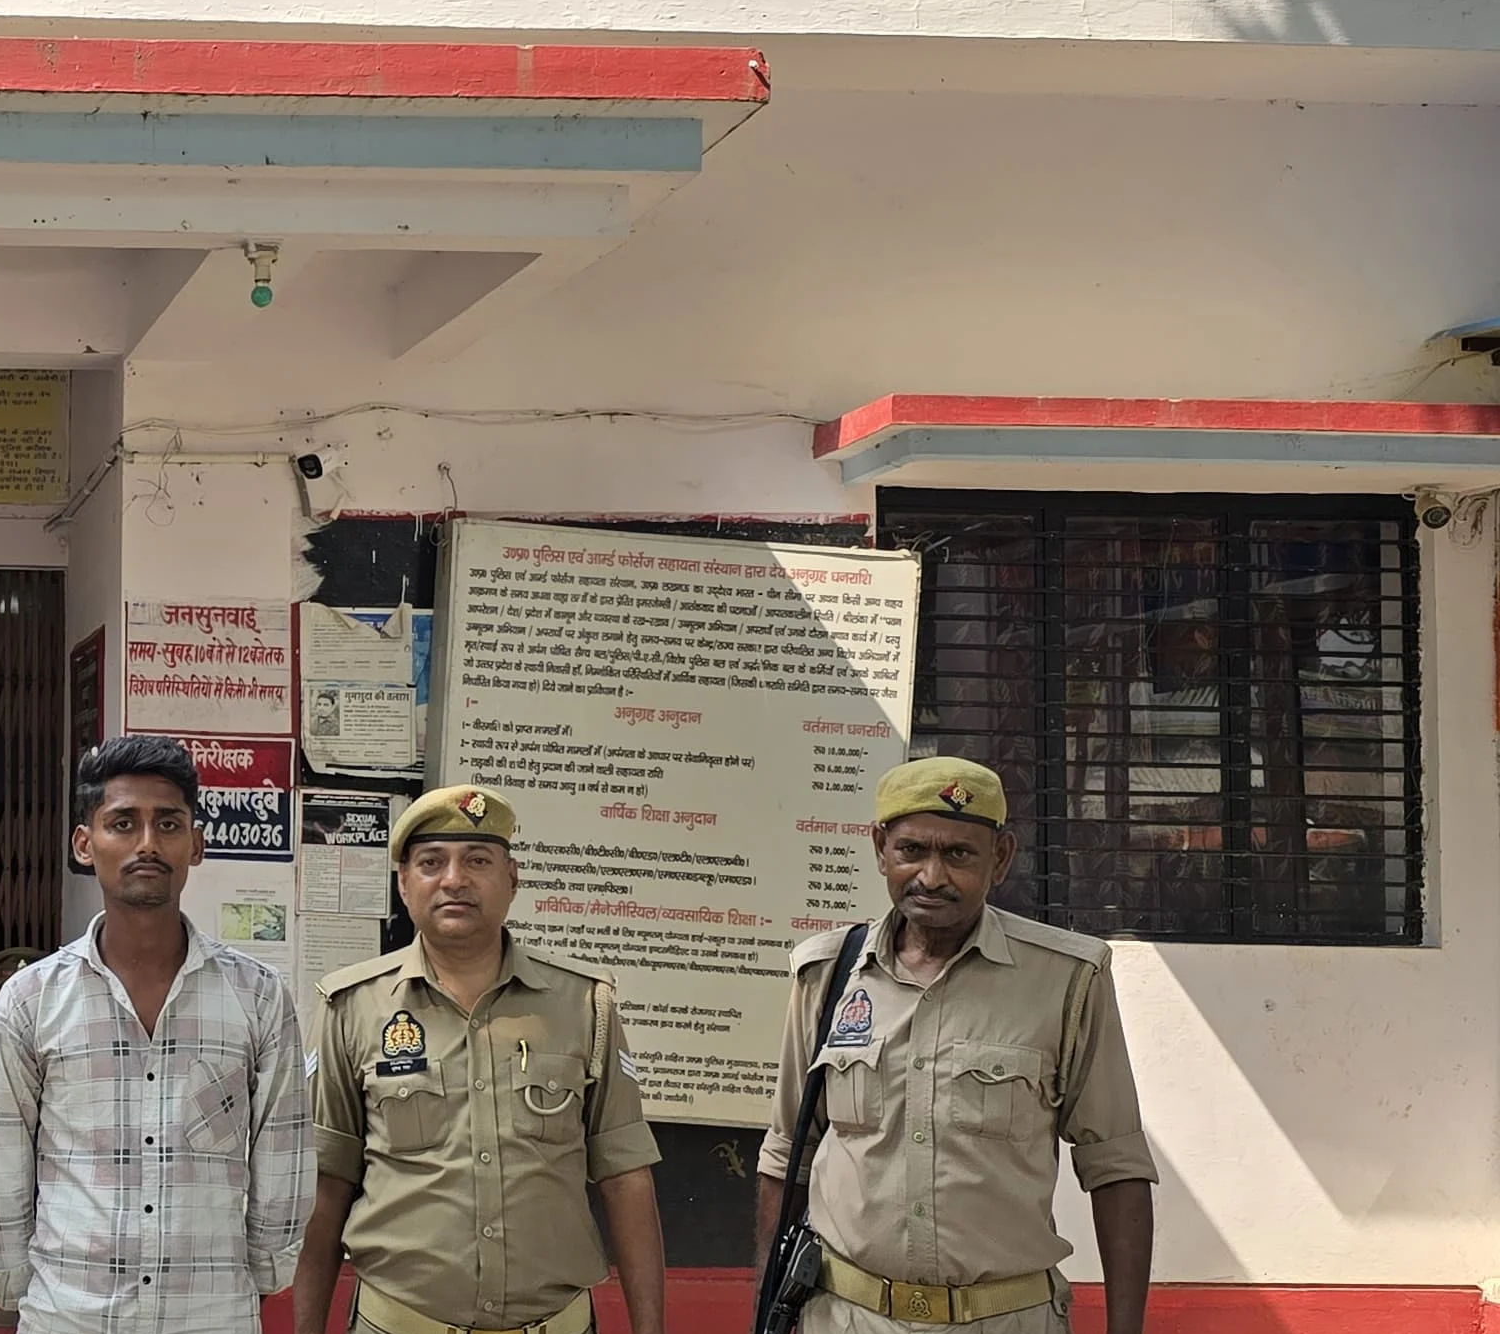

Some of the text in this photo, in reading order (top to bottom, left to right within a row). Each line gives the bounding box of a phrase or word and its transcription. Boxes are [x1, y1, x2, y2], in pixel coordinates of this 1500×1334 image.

[533, 545, 564, 566] पुलिस
[568, 548, 586, 564] एवं
[618, 551, 654, 568] फोर्सेज
[658, 555, 700, 573] सहायता
[704, 559, 741, 577] संस्थान
[745, 564, 766, 578] द्वारा
[770, 564, 786, 579] देय
[789, 567, 826, 586] अनुग्रह
[832, 569, 872, 585] धनराशि
[129, 641, 157, 663] समय
[162, 642, 194, 668] सुबह
[225, 637, 237, 665] से
[239, 646, 249, 664] 12
[250, 638, 265, 665] बजे
[266, 646, 284, 665] तक
[129, 674, 154, 697] विशेष
[155, 674, 212, 699] परिस्थितियों
[214, 676, 224, 700] में
[614, 706, 702, 729] अनुग्रह अनुदान
[802, 716, 891, 738] वर्तमान धनराशि
[190, 740, 254, 773] निरीक्षक
[250, 778, 284, 821] दुबे
[345, 813, 378, 824] SEXUAL
[600, 802, 717, 830] वार्षिक शिक्षा अनुदान
[796, 816, 876, 837] वर्तमान धनरा
[324, 828, 388, 845] WORKPLACE
[728, 908, 756, 927] शिक्षा
[791, 914, 833, 931] वर्तमान
